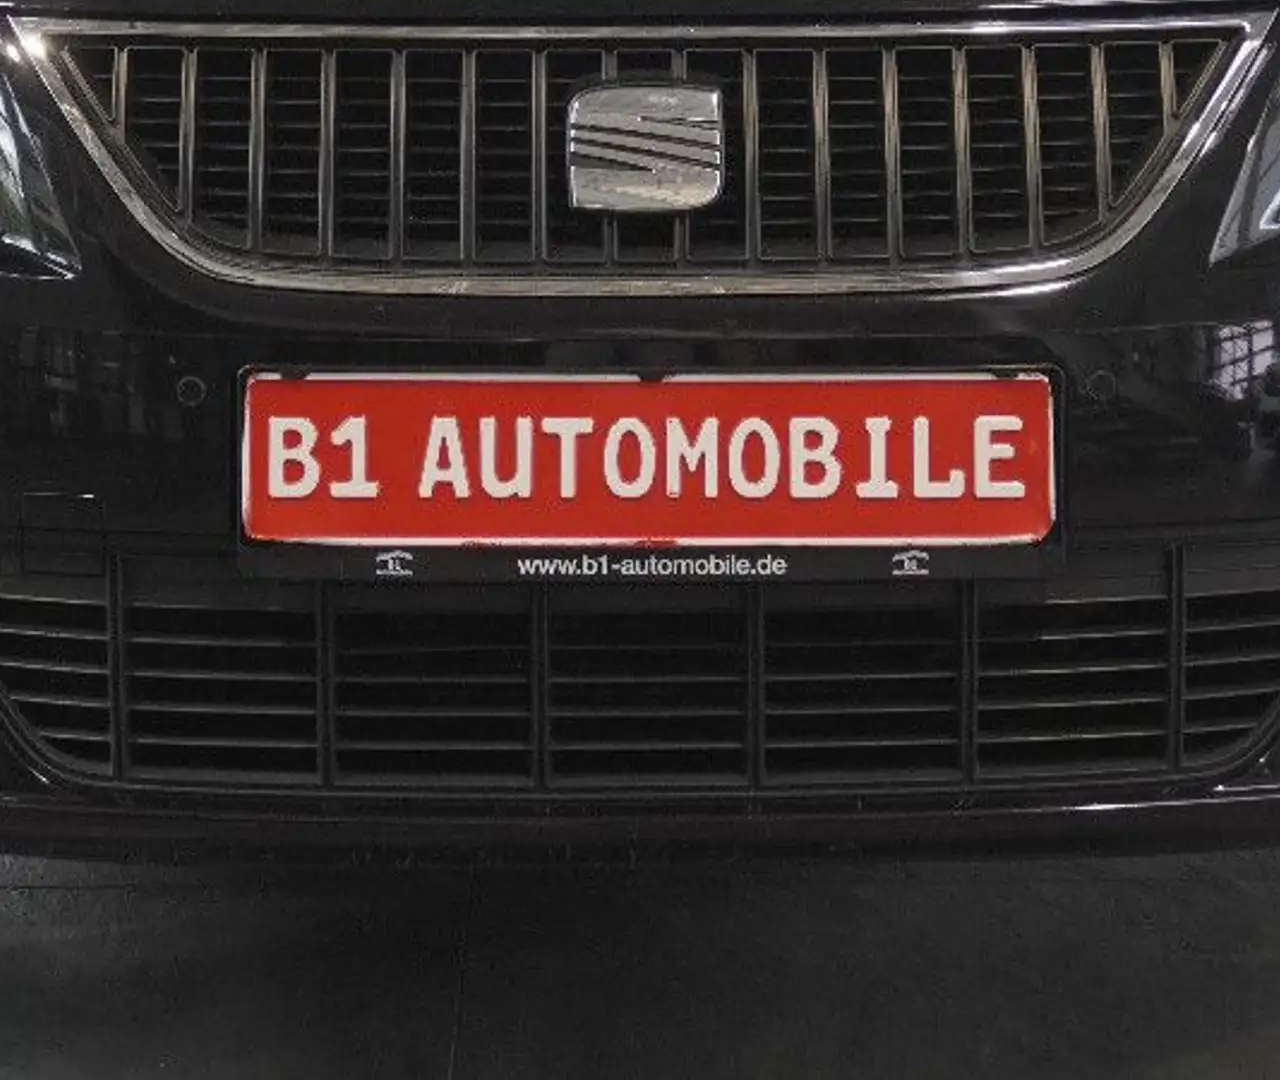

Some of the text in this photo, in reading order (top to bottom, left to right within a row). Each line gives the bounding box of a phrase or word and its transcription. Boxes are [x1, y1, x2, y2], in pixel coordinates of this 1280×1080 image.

[267, 415, 1026, 499] B1 AUTOMOBILE
[517, 554, 788, 576] www.b1-automobile.de
